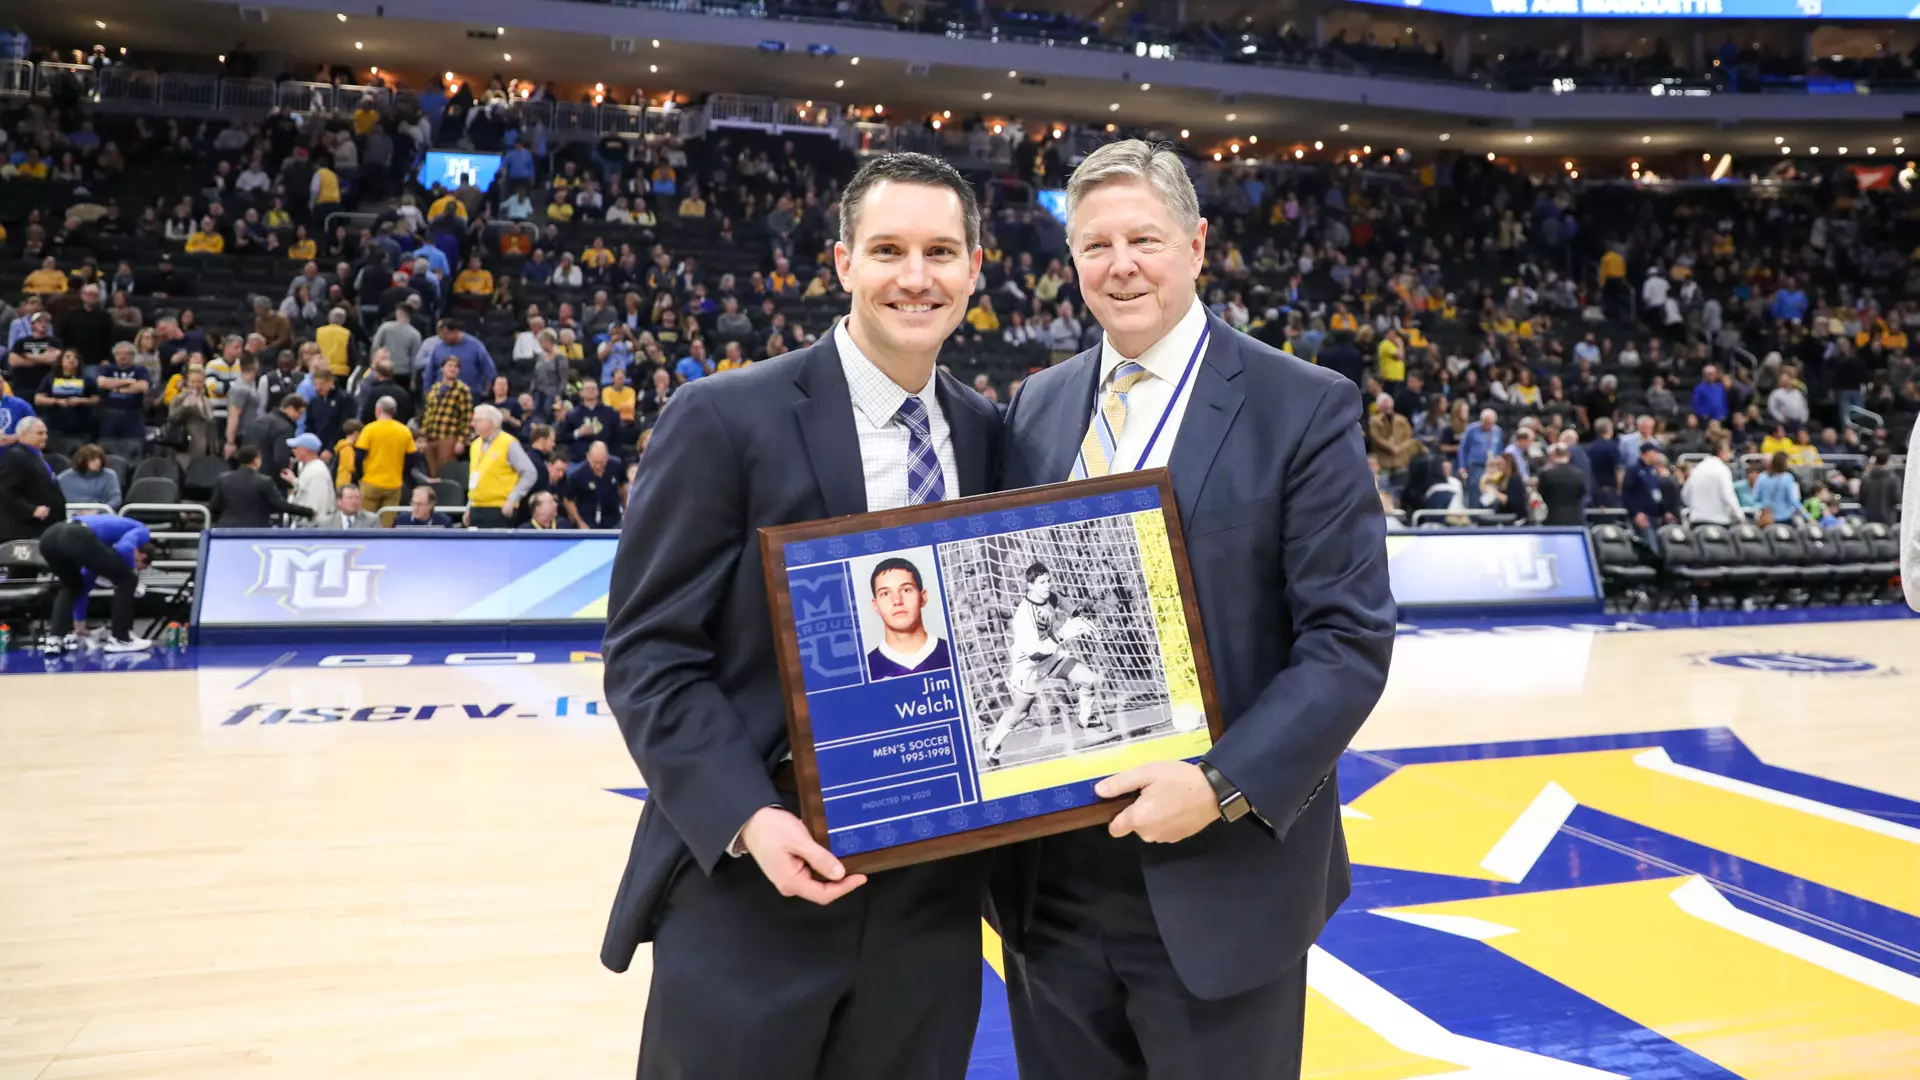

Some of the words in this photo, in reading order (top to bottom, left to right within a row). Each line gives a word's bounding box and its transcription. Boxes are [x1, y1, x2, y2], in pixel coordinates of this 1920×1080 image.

[255, 545, 378, 612] MU
[922, 677, 950, 695] Jim
[895, 694, 954, 719] Welch
[873, 743, 906, 758] MEN'S
[909, 735, 949, 751] SOCCER
[901, 746, 951, 764] 1995-1998
[862, 796, 900, 810] INDUCTED
[901, 794, 911, 803] IN
[912, 789, 932, 800] 2020
